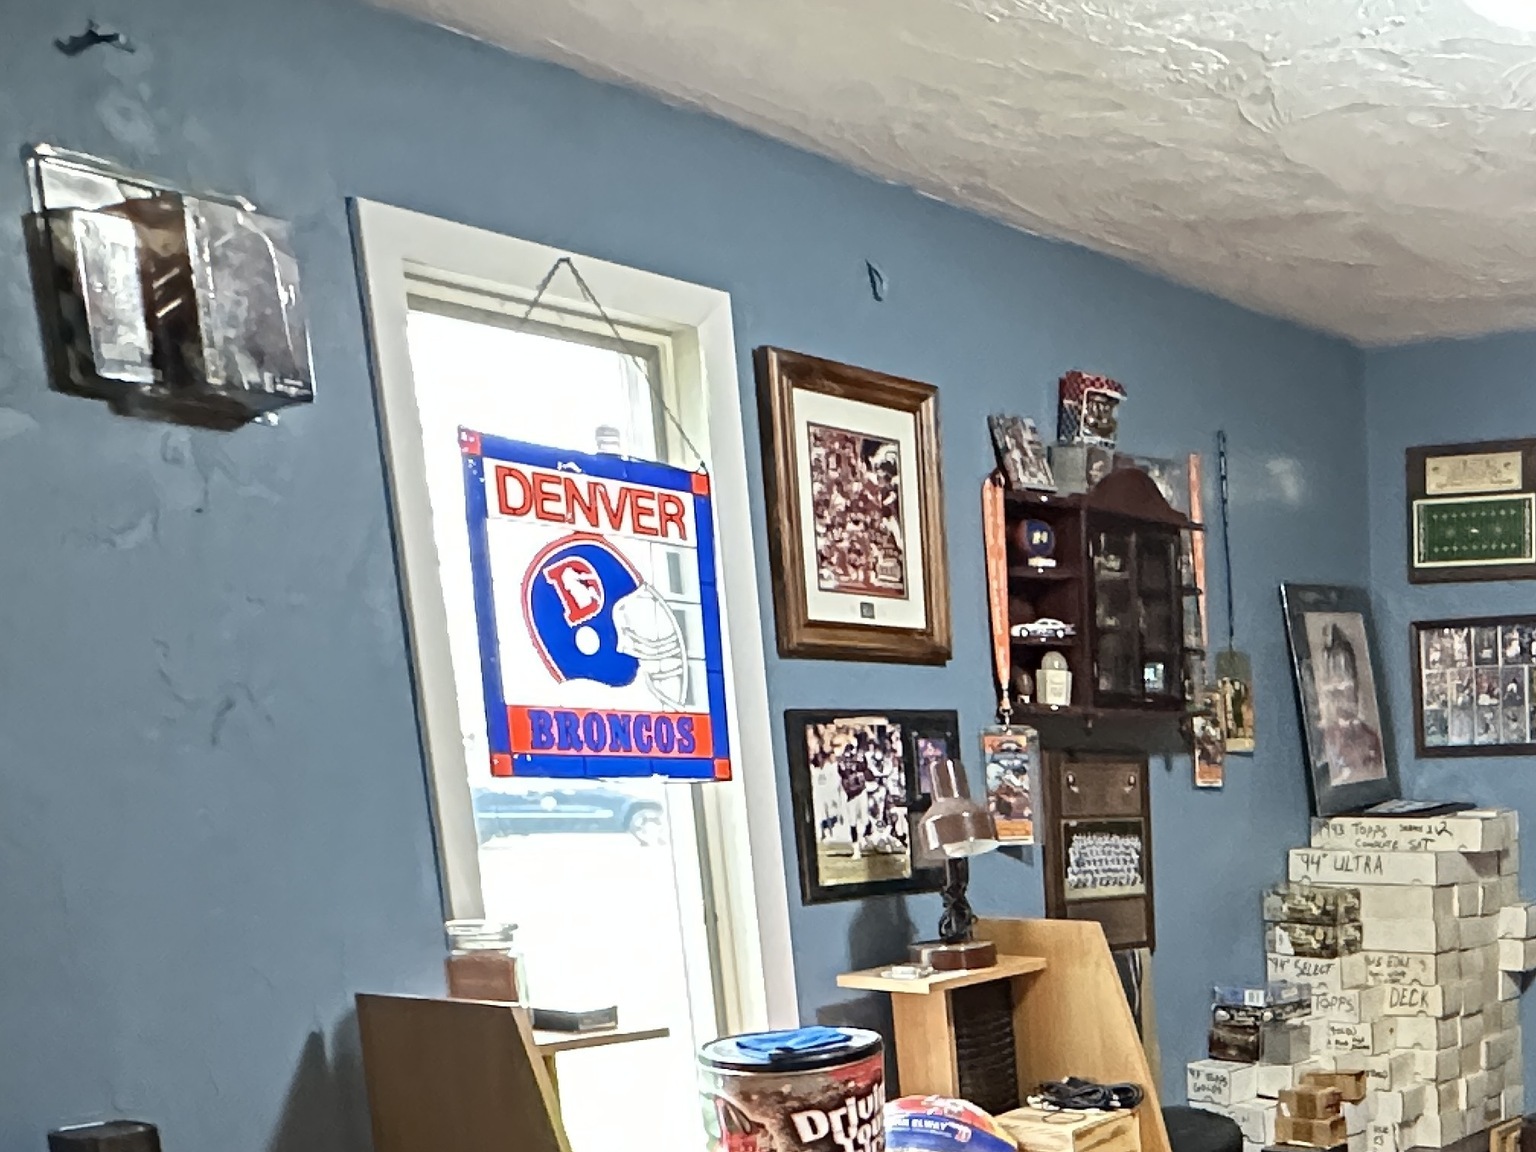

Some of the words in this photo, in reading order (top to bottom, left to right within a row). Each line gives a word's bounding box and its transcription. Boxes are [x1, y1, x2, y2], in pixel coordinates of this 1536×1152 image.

[495, 465, 687, 540] DENVER
[528, 709, 696, 755] BRONCOS
[1334, 853, 1384, 876] ULTRA
[1293, 959, 1335, 978] SELECT
[1312, 992, 1355, 1013] TOPPS
[1389, 987, 1429, 1009] DECK
